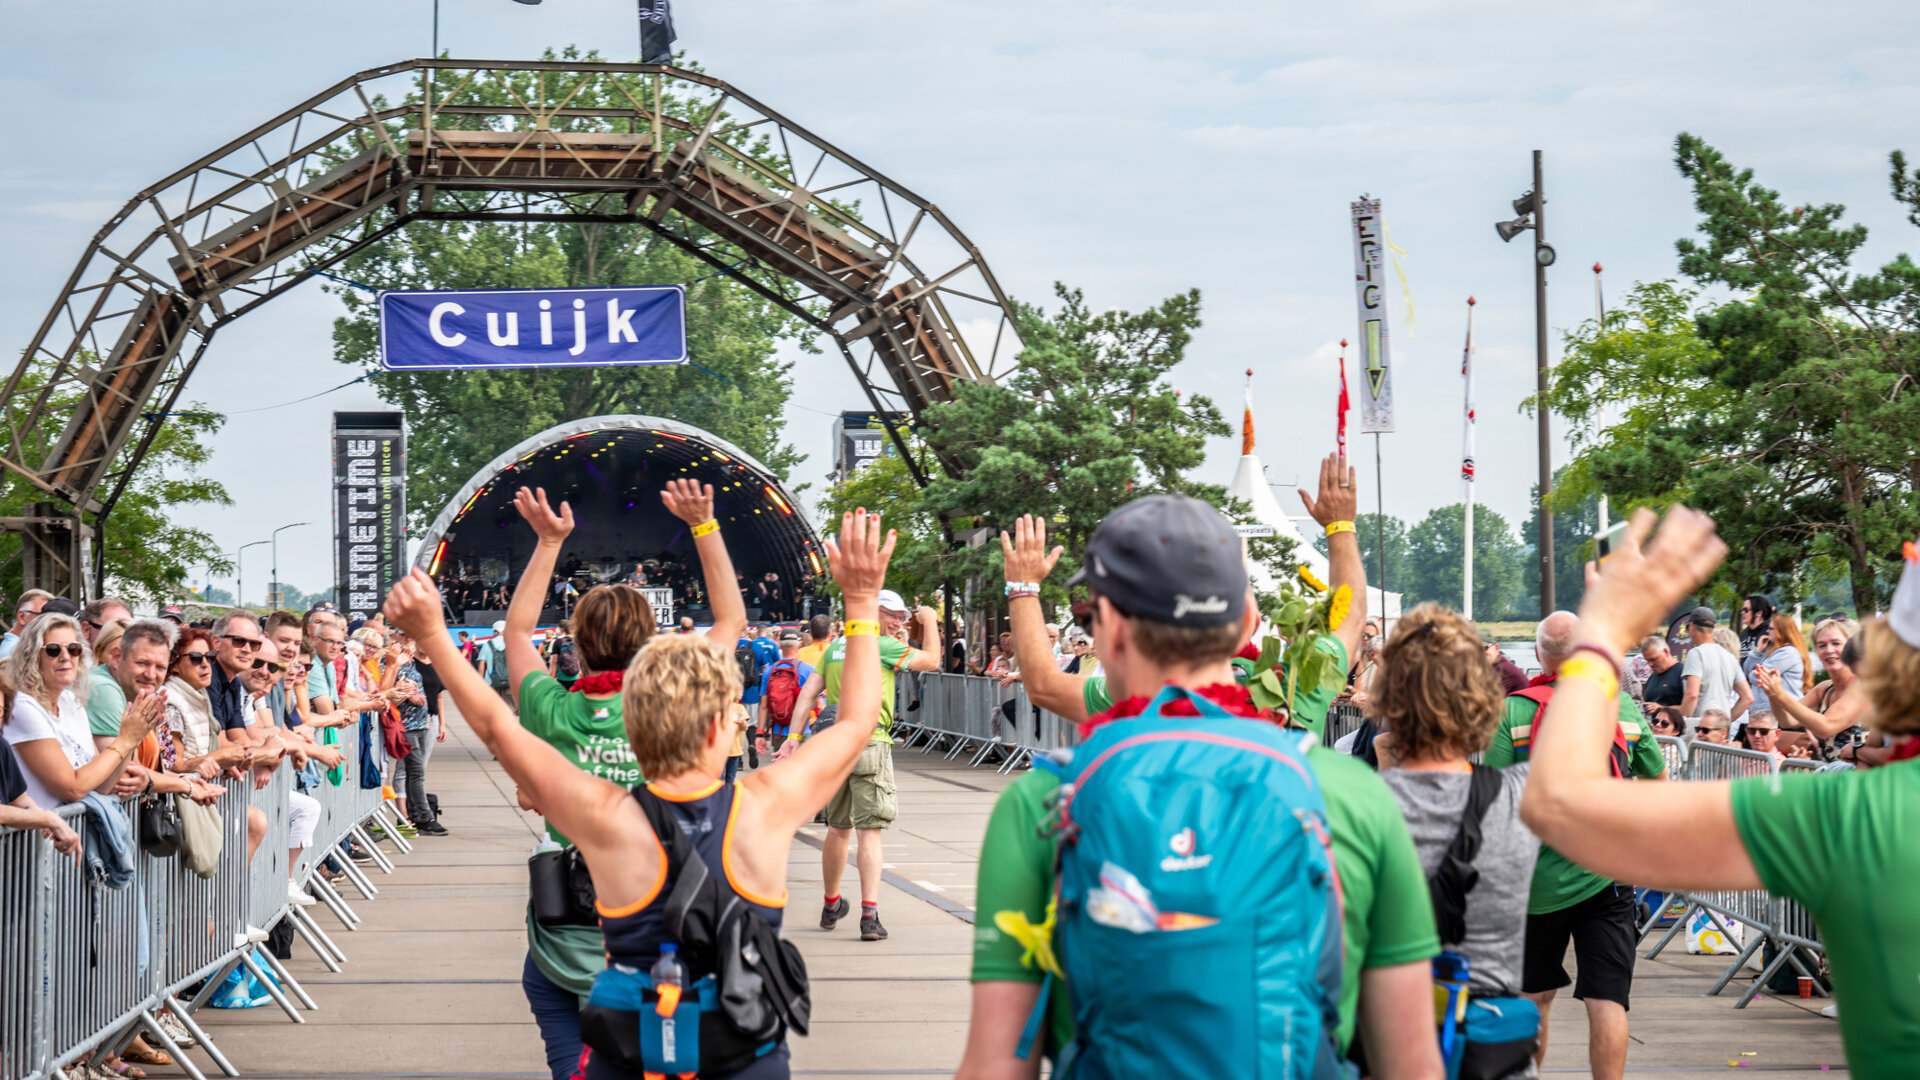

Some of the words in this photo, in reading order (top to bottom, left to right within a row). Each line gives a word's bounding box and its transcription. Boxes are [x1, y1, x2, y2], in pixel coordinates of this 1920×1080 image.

[428, 298, 639, 356] Cuijk
[381, 503, 392, 561] sfeervolle
[384, 564, 392, 583] van
[588, 734, 624, 744] The
[606, 766, 639, 782] the
